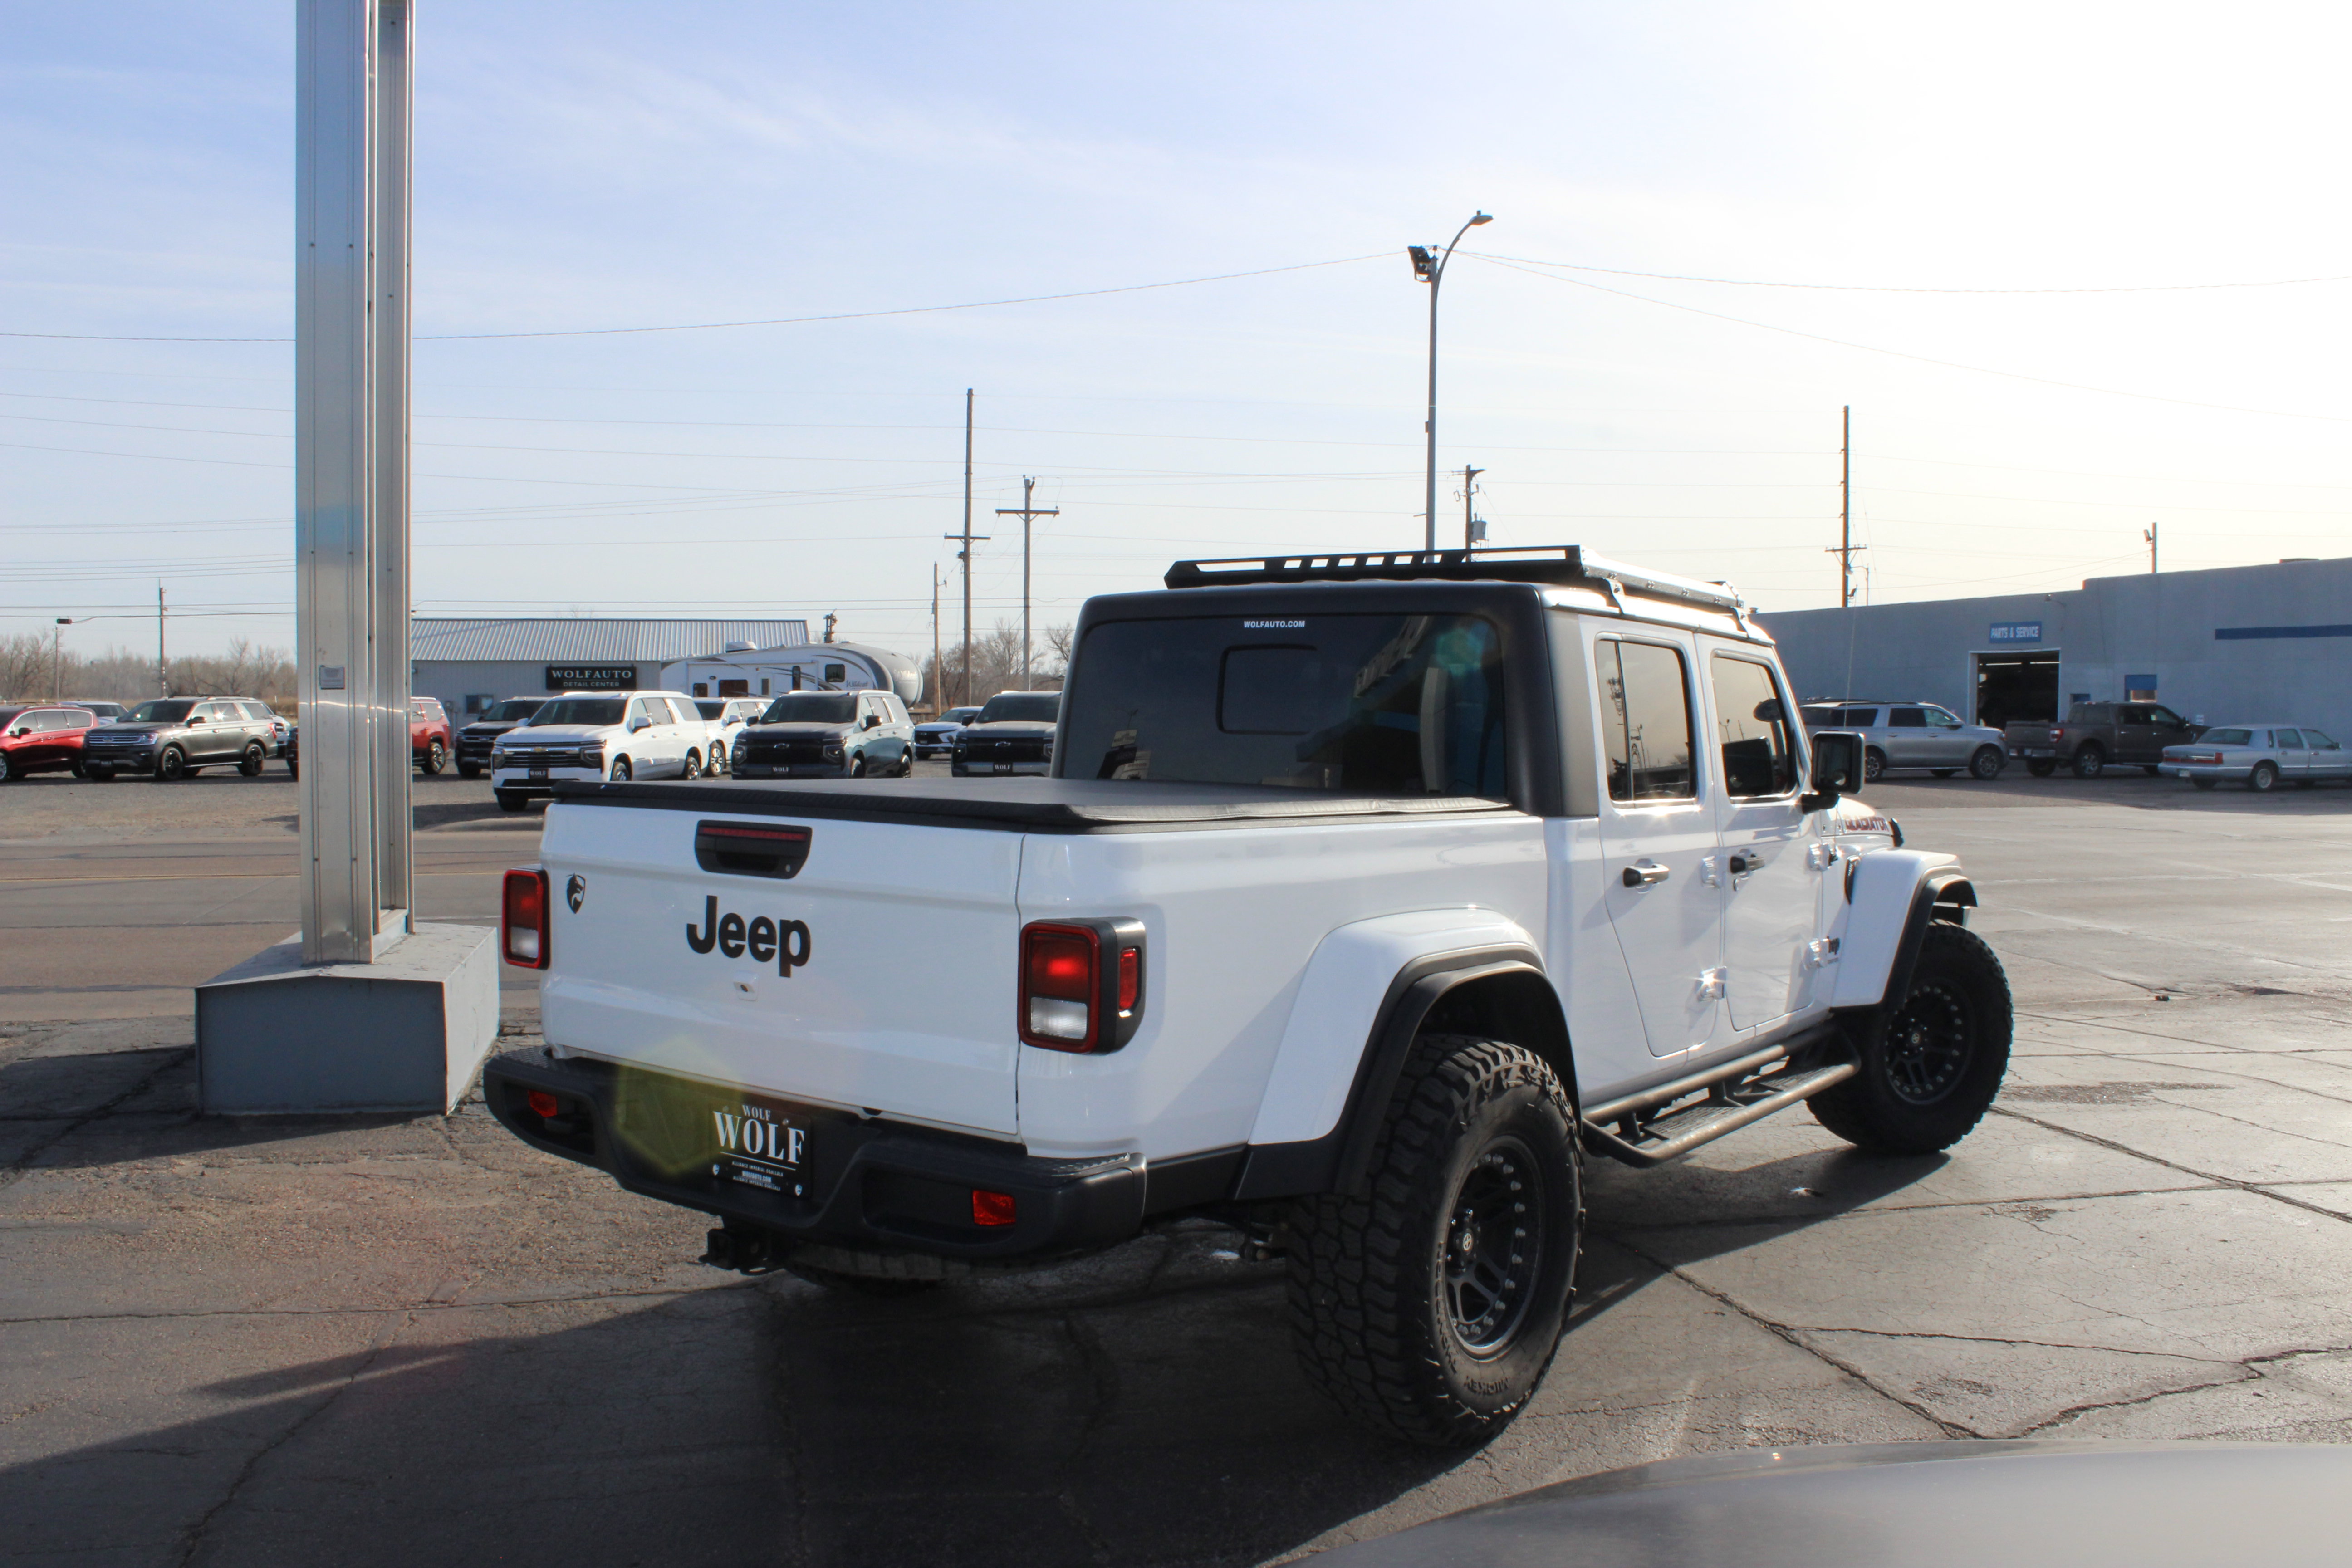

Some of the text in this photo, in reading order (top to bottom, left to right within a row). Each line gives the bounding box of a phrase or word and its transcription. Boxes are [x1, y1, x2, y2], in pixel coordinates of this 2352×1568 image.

[1990, 627, 2008, 639] PARTS
[2015, 626, 2039, 638] SERVICE
[551, 670, 632, 678] WOLFAUTO
[686, 895, 811, 978] Jeep
[742, 1104, 771, 1121] WOLF
[713, 1111, 804, 1164] WOLF
[749, 1164, 765, 1173] IMPERIAL
[749, 1179, 764, 1187] IMPERIAL
[1464, 1376, 1509, 1396] MICKEY
